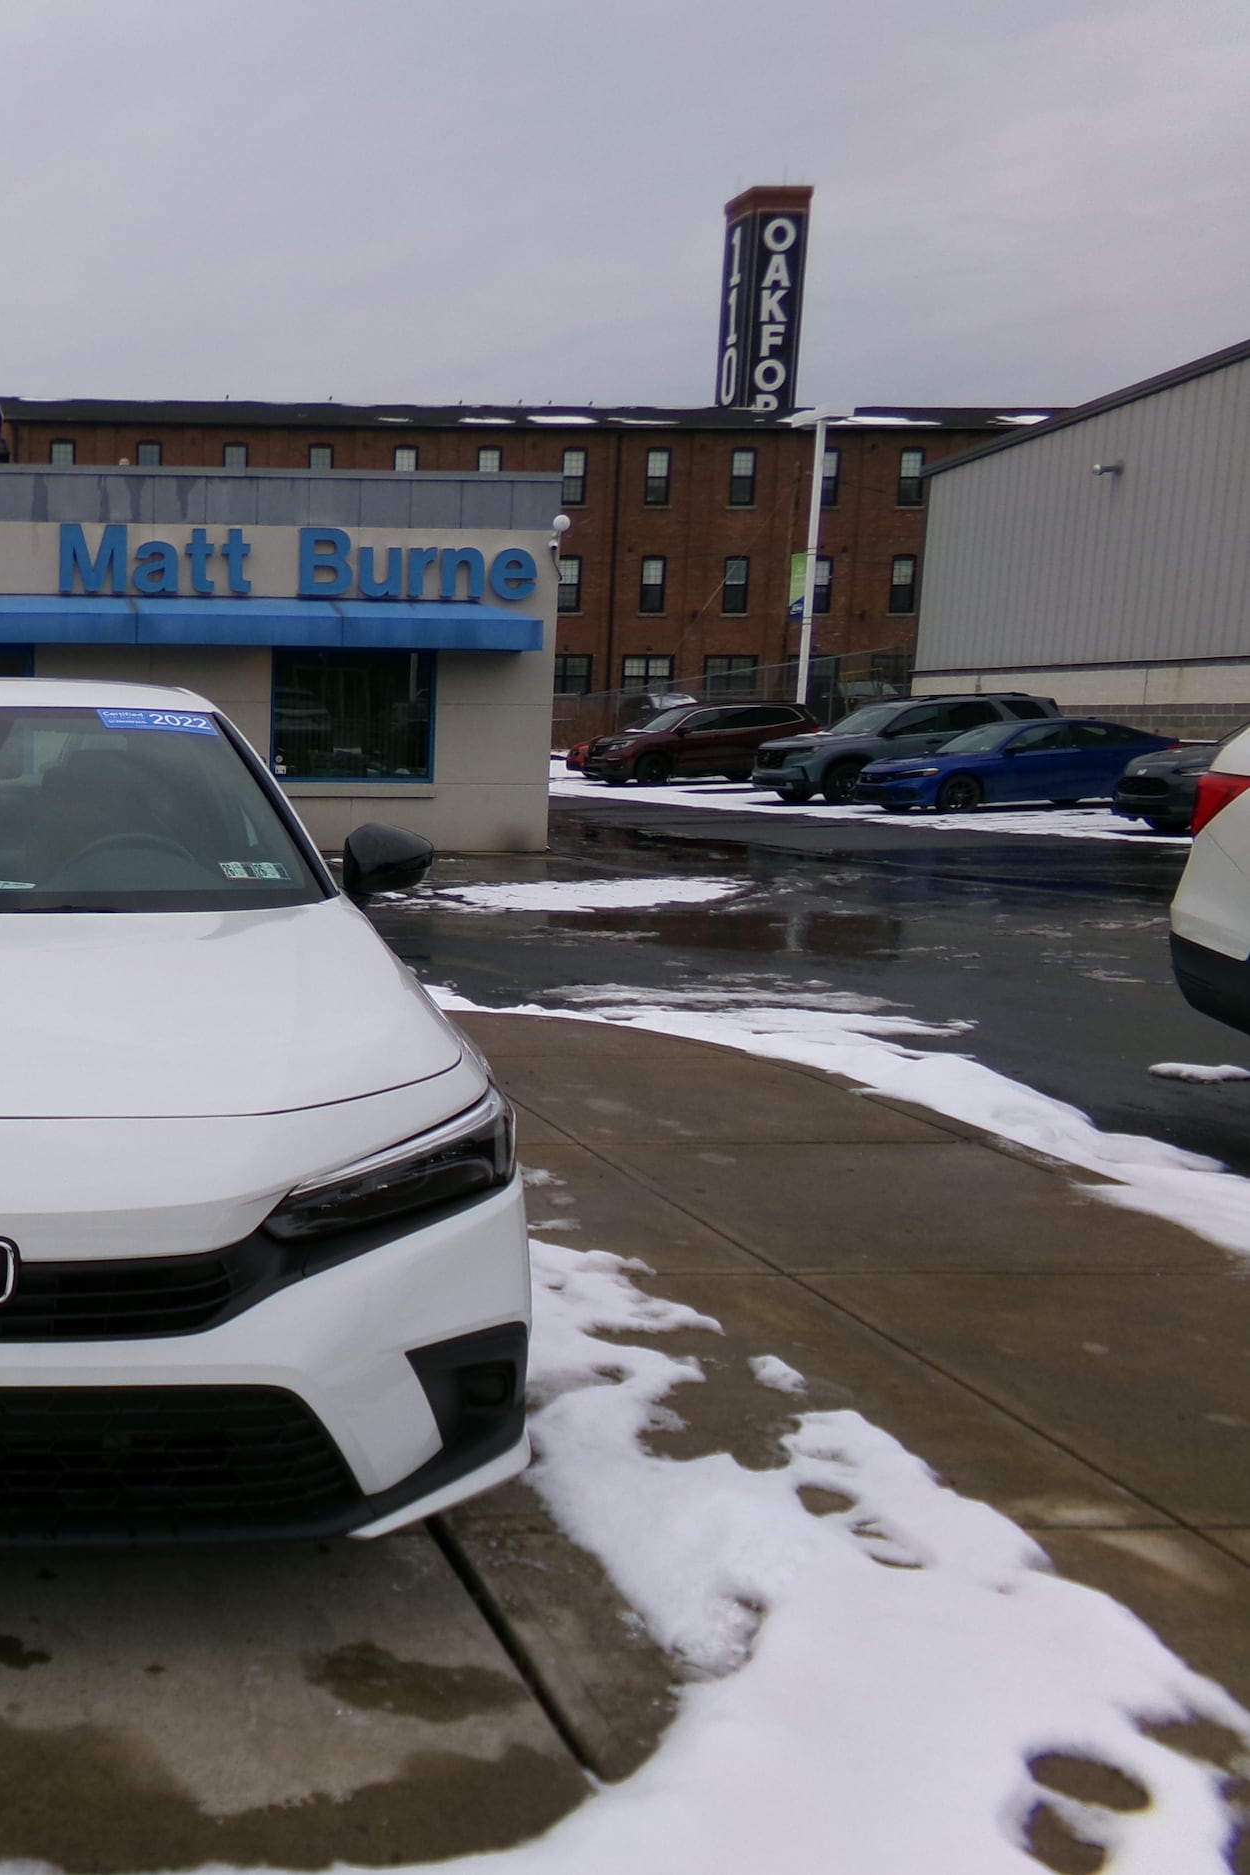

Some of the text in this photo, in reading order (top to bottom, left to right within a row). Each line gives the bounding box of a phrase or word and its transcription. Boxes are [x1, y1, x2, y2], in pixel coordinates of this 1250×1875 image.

[59, 522, 538, 600] Matt Burne
[149, 713, 211, 730] 2022
